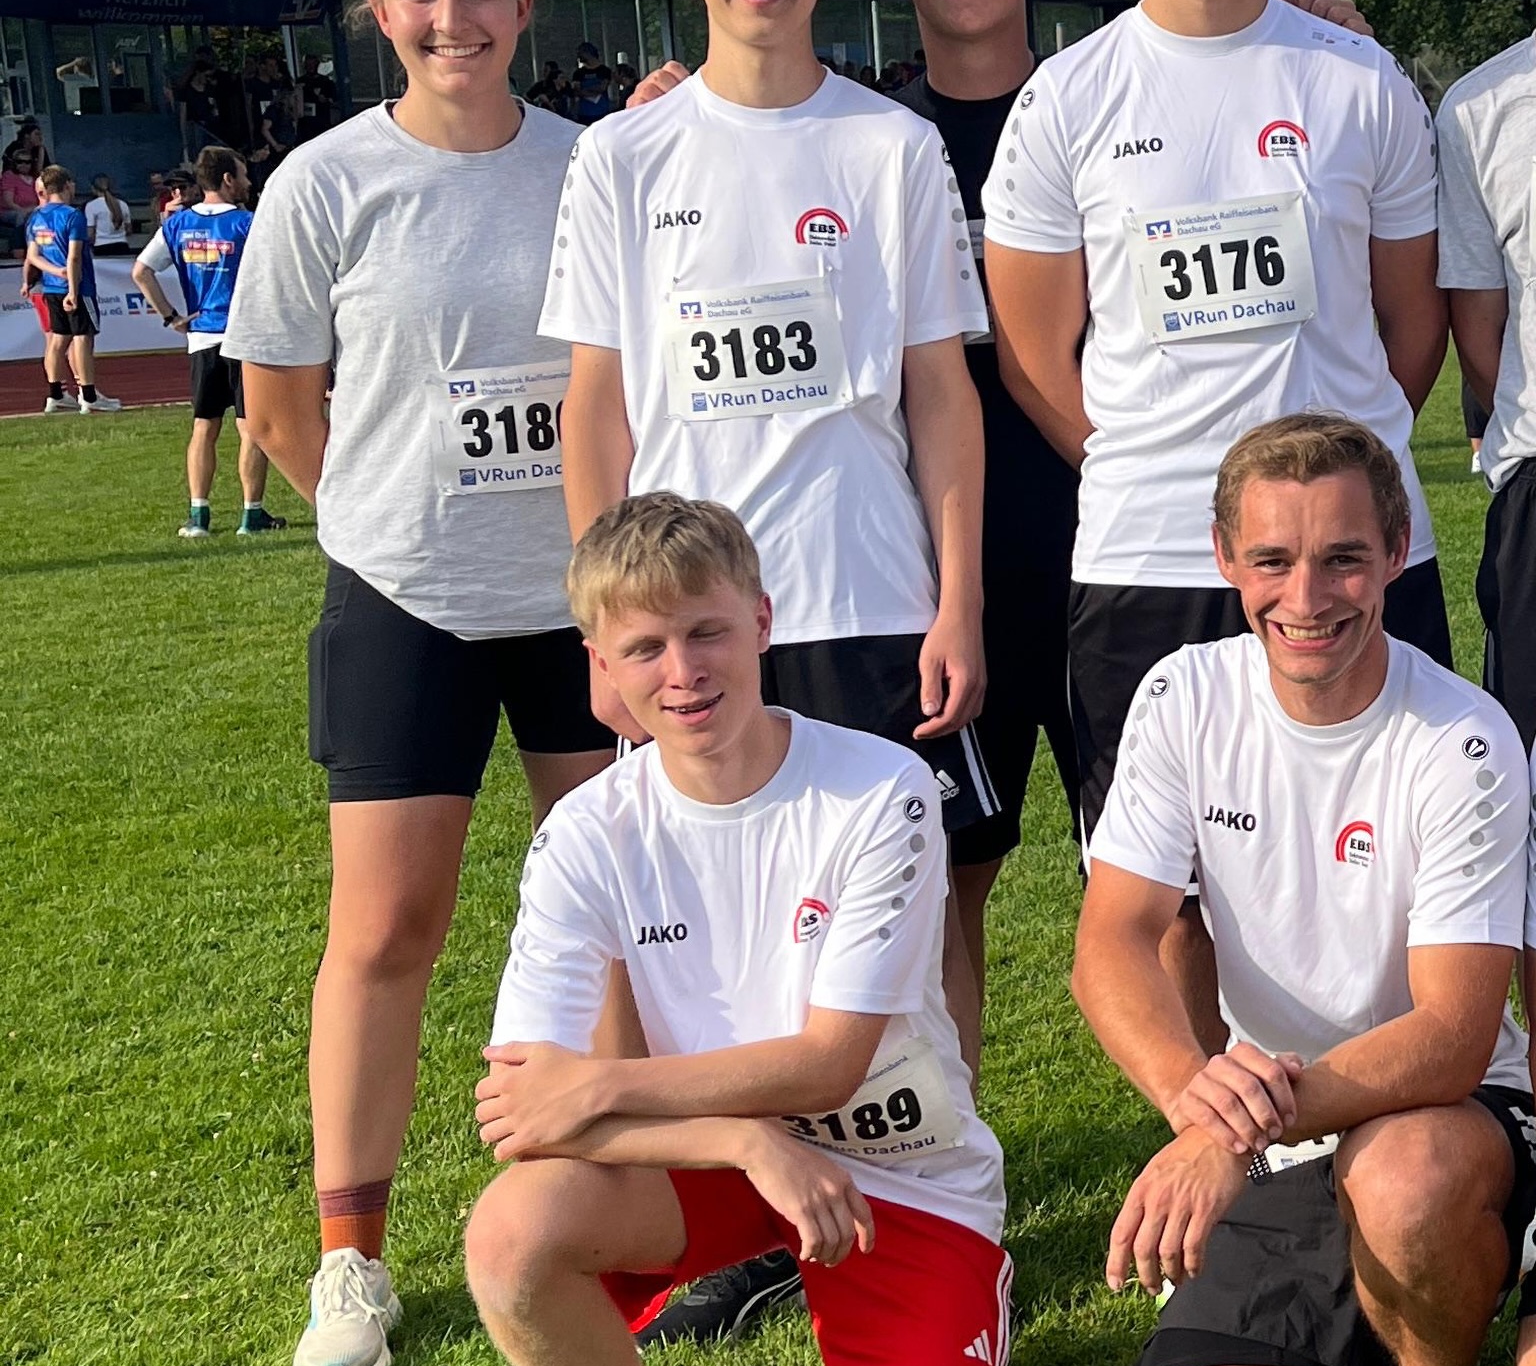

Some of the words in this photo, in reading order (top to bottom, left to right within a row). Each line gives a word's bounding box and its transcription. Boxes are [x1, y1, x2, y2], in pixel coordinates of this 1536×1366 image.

[1112, 137, 1163, 159] JAKO
[1271, 135, 1297, 146] EBS
[654, 210, 702, 229] JAKO
[1176, 213, 1217, 226] Volksbank
[1219, 205, 1279, 219] Raiffeisenbank
[809, 223, 836, 234] EBS
[1177, 225, 1208, 235] Dachau
[1209, 222, 1221, 231] eG
[1160, 236, 1285, 301] 3176
[2, 299, 34, 312] Volksb
[706, 298, 748, 309] Volksbank
[1181, 309, 1227, 326] VRun
[1233, 299, 1295, 319] Dachau
[707, 309, 738, 318] Dachau
[691, 320, 817, 382] 3183
[481, 387, 513, 396] Dachau
[708, 392, 756, 409] VRun
[762, 384, 828, 403] Dachau
[478, 466, 526, 483] VRun
[532, 464, 562, 478] Dac
[1204, 804, 1257, 832] JAKO
[637, 923, 688, 945] JAKO
[781, 1087, 922, 1141] 3189
[863, 1136, 937, 1155] Dachau
